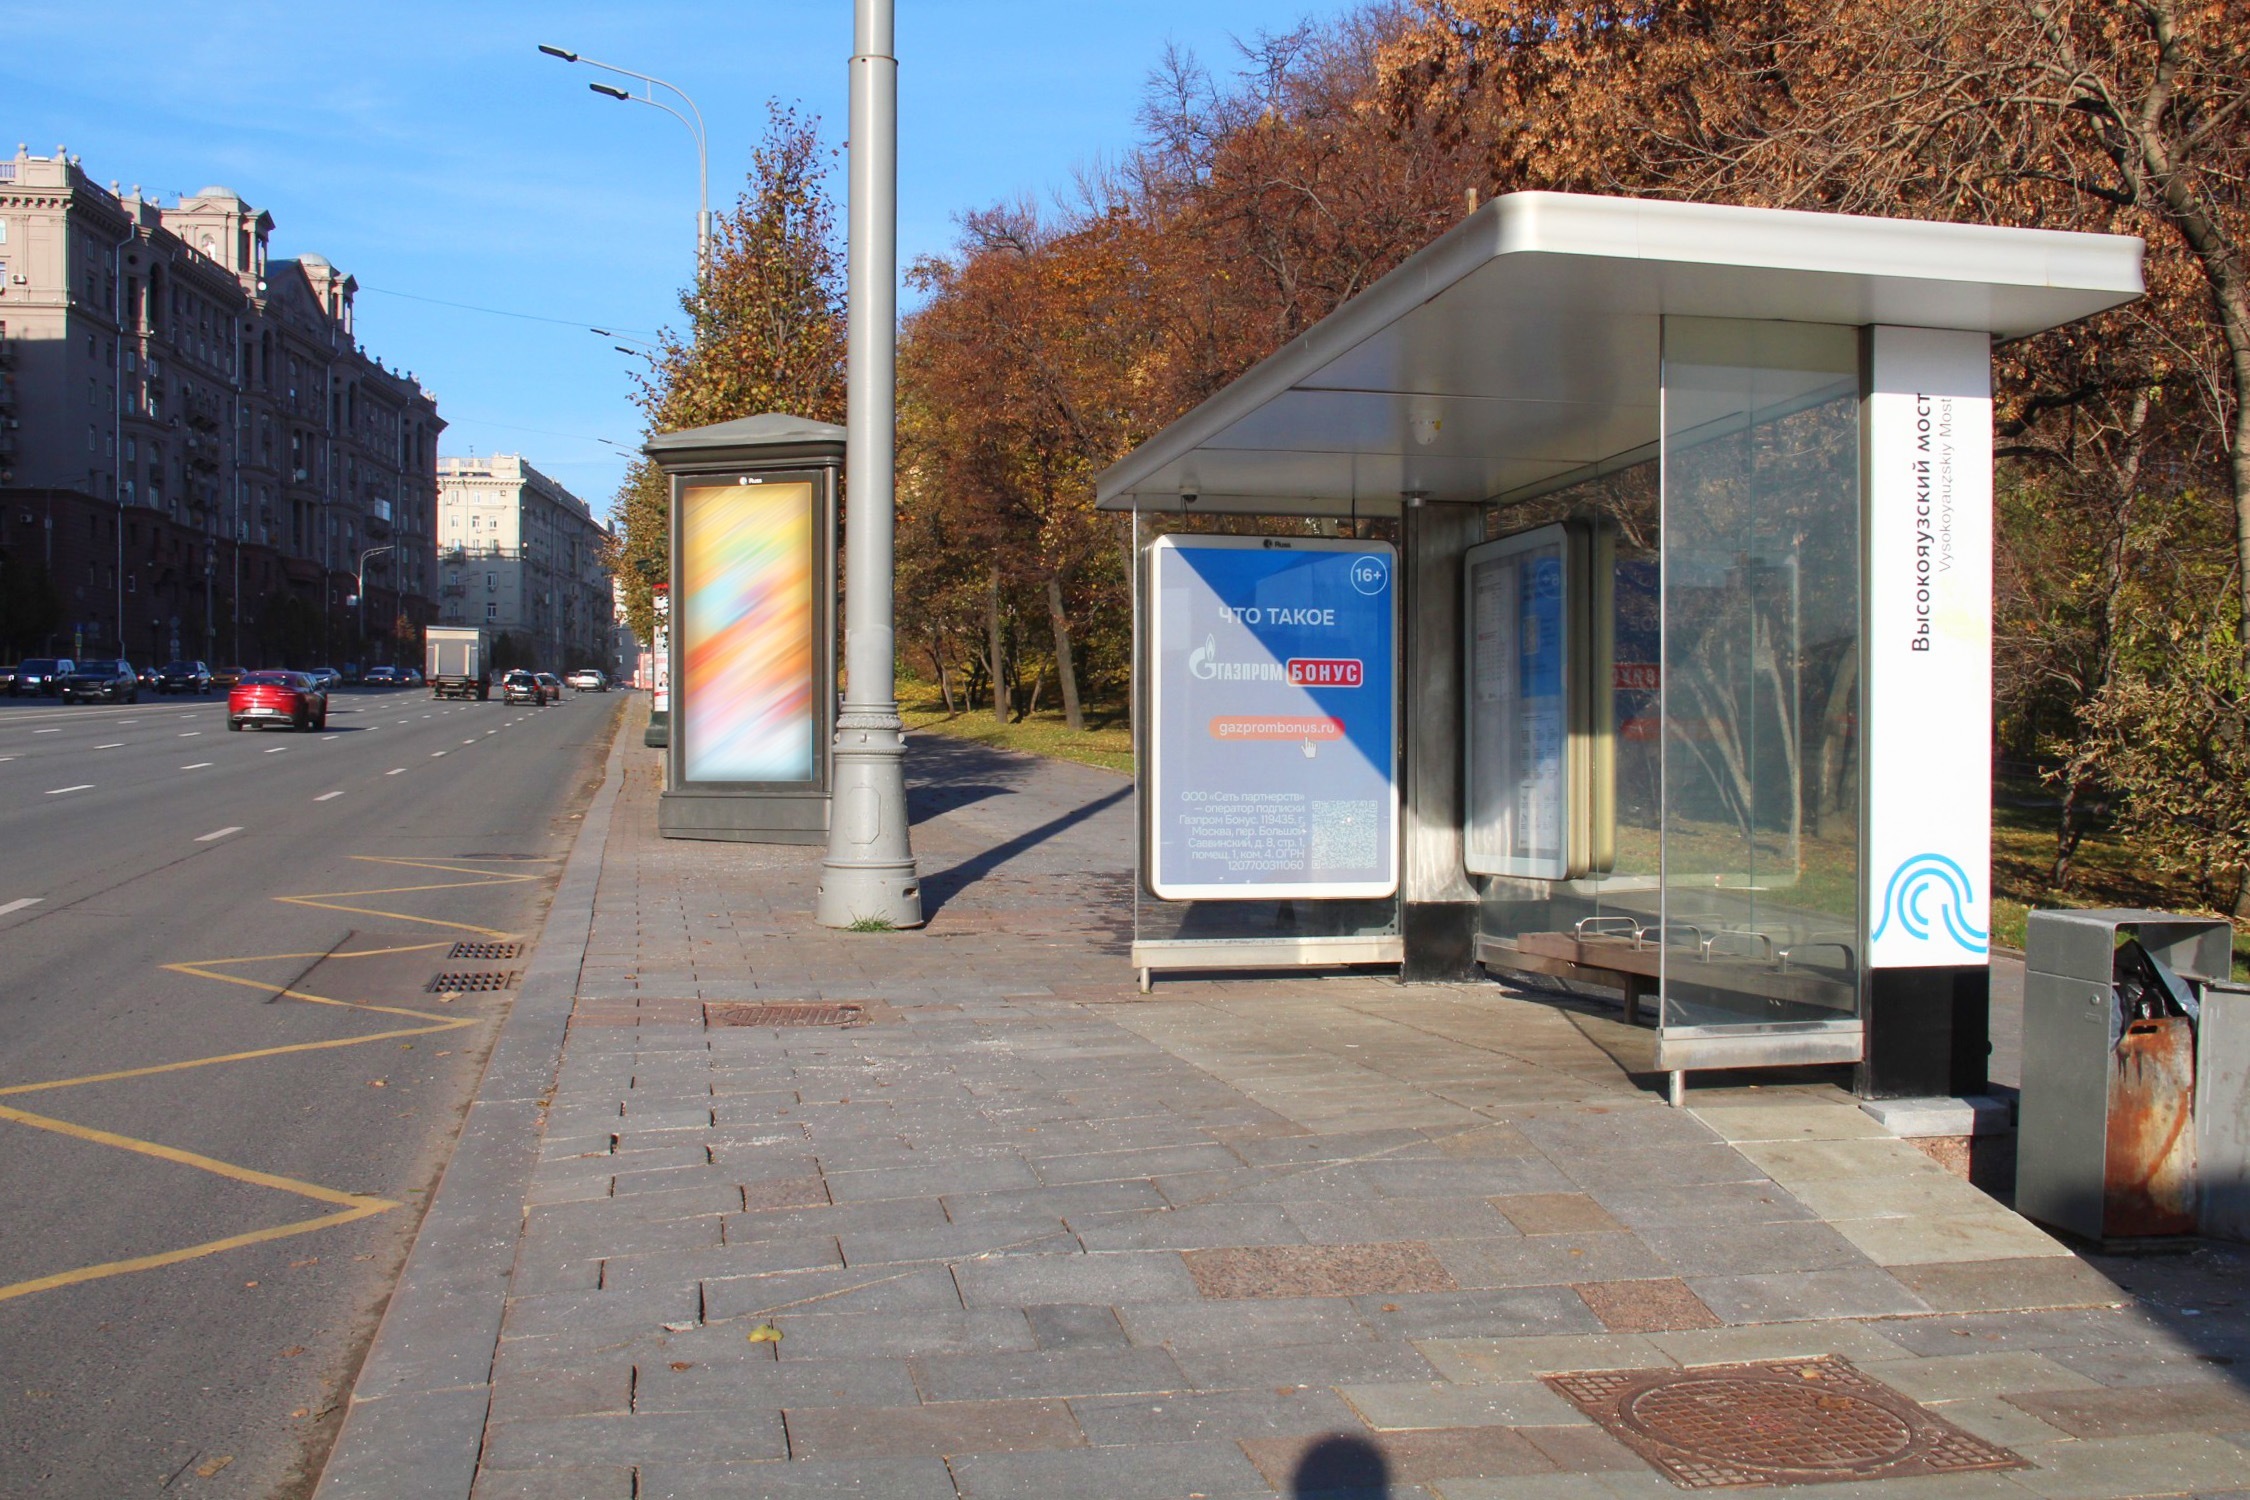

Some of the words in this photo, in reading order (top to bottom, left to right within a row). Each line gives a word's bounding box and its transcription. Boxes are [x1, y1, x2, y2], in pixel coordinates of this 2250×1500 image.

[1916, 392, 1931, 452] мост
[1938, 397, 1952, 437] Most
[1938, 443, 1955, 573] Vysokoyauzskiy
[1911, 459, 1935, 652] Высокояузский
[1354, 568, 1382, 582] 16+
[1218, 607, 1261, 625] ЧТО
[1266, 608, 1335, 626] ТАКОЕ
[1217, 662, 1283, 681] ГАЗПРОМ
[1291, 664, 1358, 682] БОНУС
[1218, 720, 1335, 736] gazprombonus.ru
[1181, 791, 1208, 802] ООО
[1204, 804, 1255, 815] оператор
[1256, 804, 1306, 815] подписки
[1179, 814, 1223, 826] Газпром
[1191, 826, 1234, 837] Москва,
[1235, 827, 1257, 839] пер.
[1275, 848, 1305, 859] ОГРН
